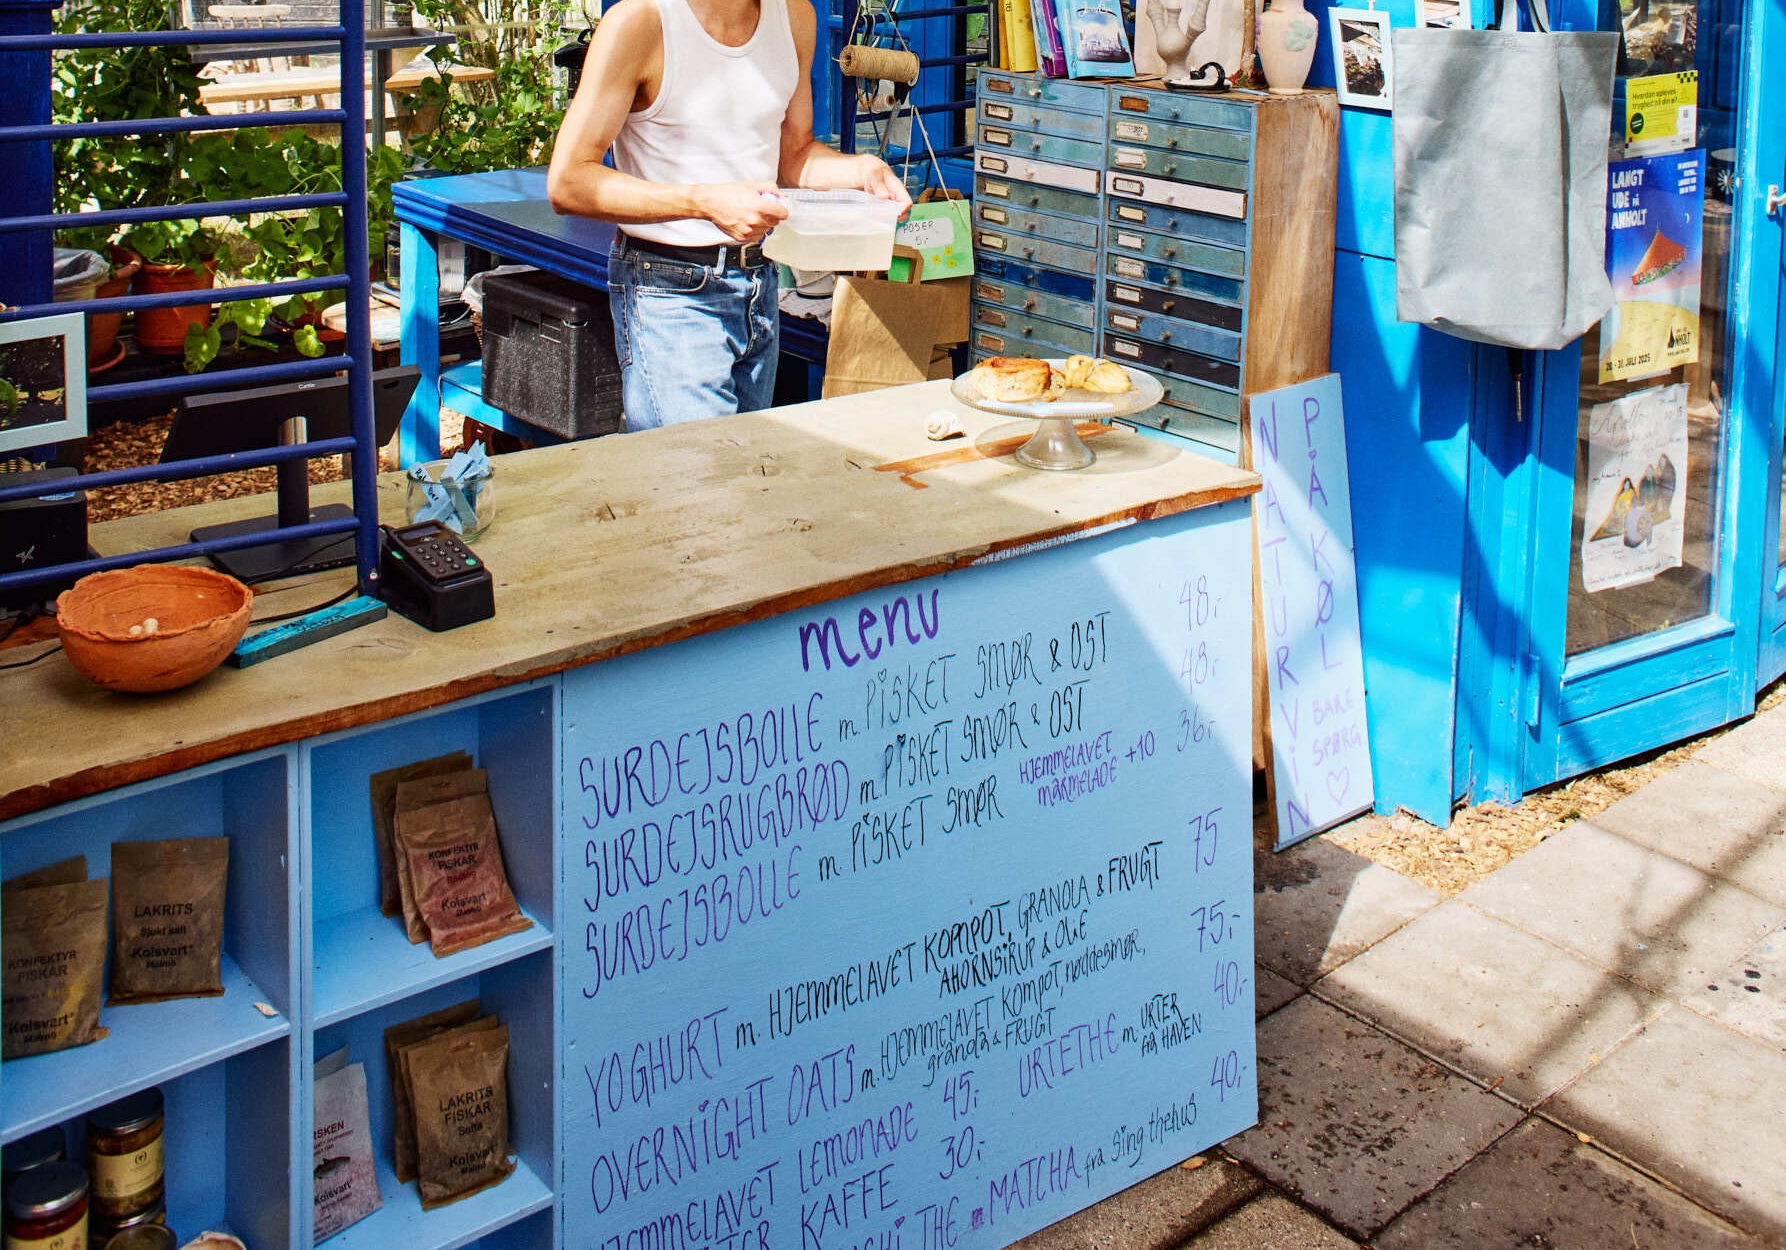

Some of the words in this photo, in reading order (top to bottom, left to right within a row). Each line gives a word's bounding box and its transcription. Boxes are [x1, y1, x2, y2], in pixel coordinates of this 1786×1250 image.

[1612, 169, 1644, 189] LANGT
[1612, 191, 1630, 209] UDE
[902, 220, 936, 234] POSER
[1611, 209, 1648, 230] ANHOLT
[1050, 638, 1062, 672] &
[1071, 611, 1111, 671] OST
[1312, 686, 1354, 726] BARE
[1124, 730, 1155, 763] +10
[585, 760, 850, 911] SURDEJSRUGBRØD
[1030, 702, 1041, 726] &
[1050, 679, 1091, 738] OST
[1188, 807, 1223, 872] 75
[134, 903, 193, 918] LAKRITS
[441, 892, 487, 910] Kolsvart
[132, 945, 188, 958] Kolsvart
[17, 964, 68, 983] FISKAR
[584, 1007, 729, 1129] YOGHURT
[1018, 874, 1091, 930] GRANOLA
[1096, 873, 1104, 897] &
[1108, 841, 1164, 893] FRUGT
[9, 1013, 69, 1035] Kolsvart
[1005, 1007, 1056, 1050] FRUGT
[1141, 992, 1186, 1030] URTER
[1162, 1013, 1202, 1050] HAVEN
[1018, 1012, 1119, 1098] URTETHE
[439, 1086, 494, 1112] LAKRITS
[788, 1044, 855, 1126] OATS
[444, 1101, 492, 1125] FISKAR
[799, 1101, 919, 1194] LEMONADE
[801, 1163, 898, 1250] KAFFE
[915, 1196, 959, 1250] THE
[989, 1146, 1082, 1226] MATCHA
